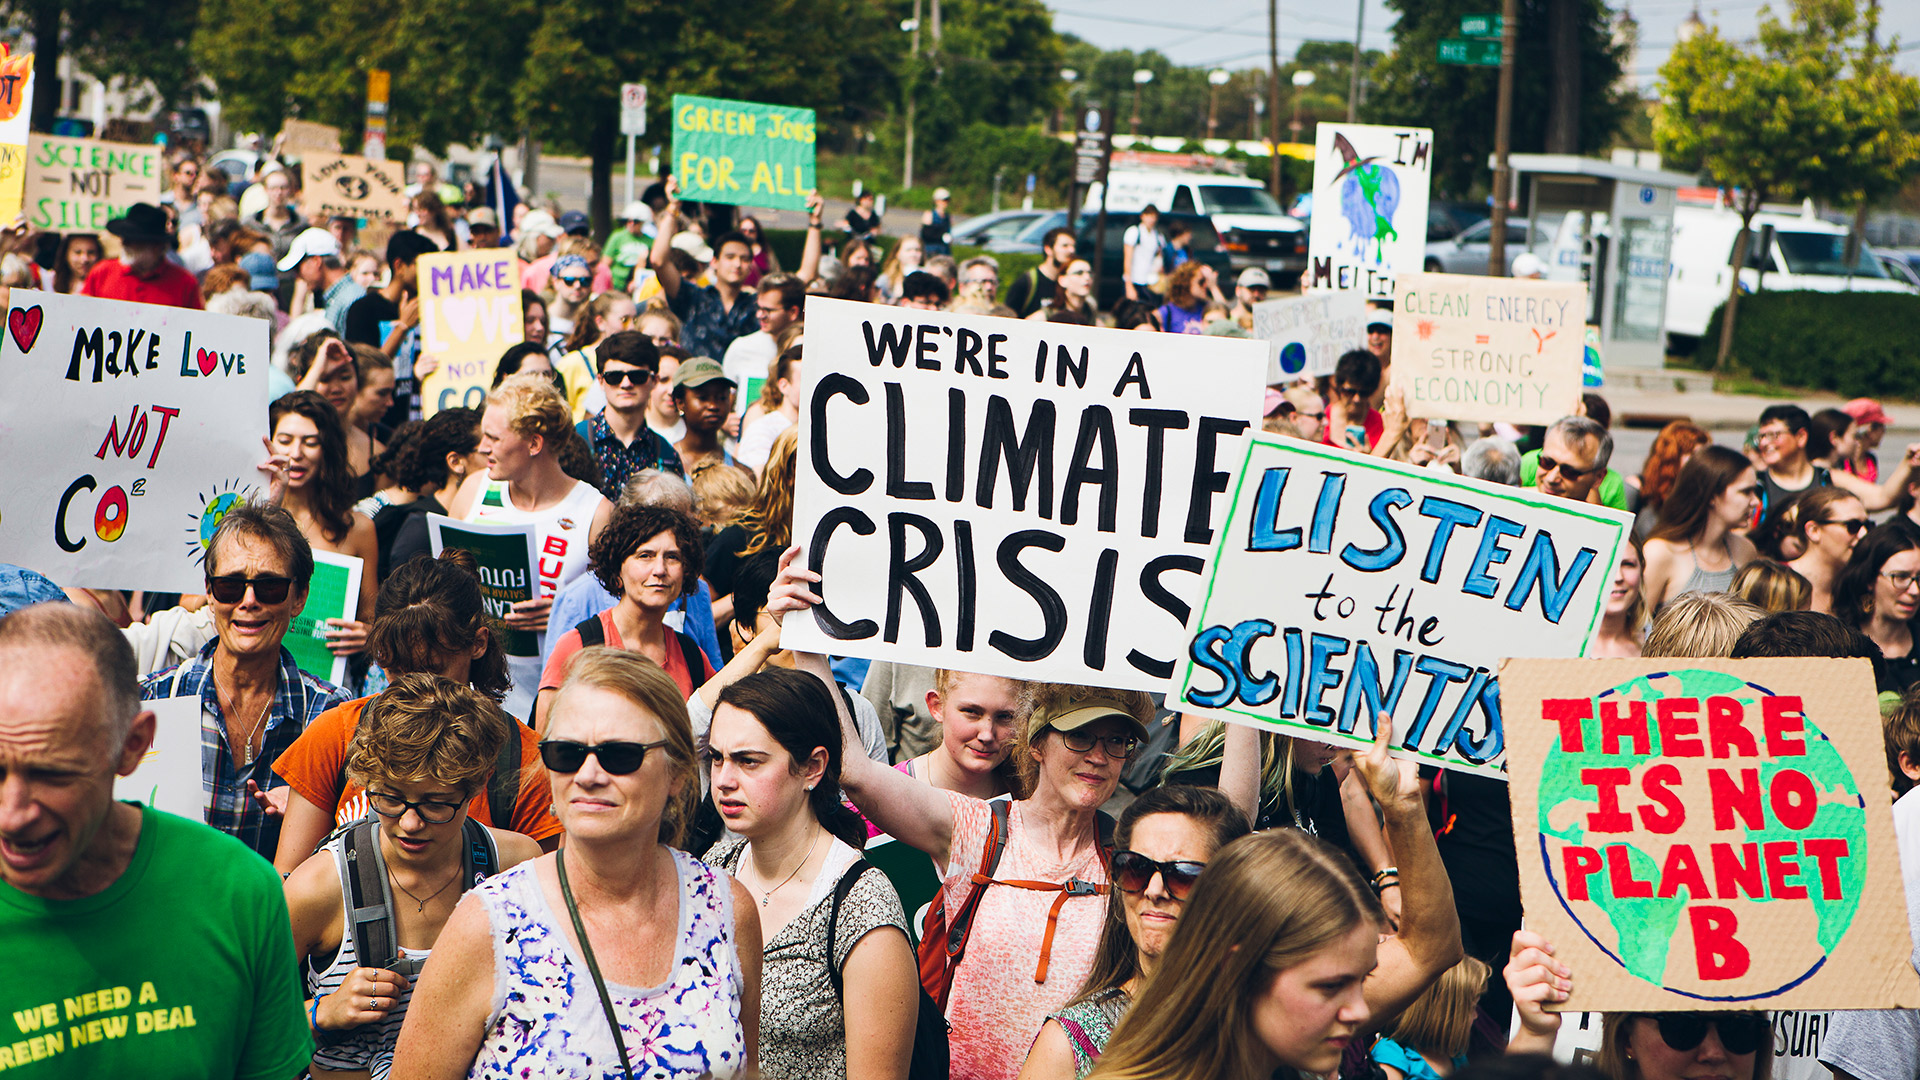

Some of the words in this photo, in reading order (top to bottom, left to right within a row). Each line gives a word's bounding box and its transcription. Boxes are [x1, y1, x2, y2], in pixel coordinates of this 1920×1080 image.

[677, 104, 756, 136] GREEN
[35, 142, 155, 178] SCIENCE
[680, 152, 740, 191] FOR
[752, 161, 813, 196] ALL
[70, 171, 112, 196] NOT
[31, 198, 133, 229] SILEN
[431, 262, 511, 296] MAKE
[1313, 256, 1396, 297] MELTI
[1253, 295, 1332, 339] RESPECT
[1404, 292, 1469, 317] CLEAN
[1486, 296, 1569, 327] ENERGY
[448, 360, 487, 380] NOT
[862, 320, 1009, 379] WE'RE
[1035, 340, 1089, 389] IN
[1113, 351, 1151, 399] A
[1431, 347, 1533, 378] STRONG
[1415, 377, 1549, 409] ECONOMY
[94, 404, 180, 469] NOT
[811, 373, 1250, 544] CLIMATE
[1244, 467, 1598, 624] LISTEN
[808, 506, 1205, 679] CRISIS
[1305, 573, 1355, 621] to
[1375, 583, 1444, 646] the
[1187, 618, 1506, 768] SCIENTIS
[1541, 695, 1807, 759] THERE
[1580, 763, 1686, 835] IS
[1707, 768, 1818, 831] NO
[1562, 838, 1849, 901] PLANET
[1688, 905, 1751, 981] B
[13, 1002, 59, 1034] WE
[63, 986, 132, 1021] NEED
[138, 981, 158, 1005] A
[69, 1015, 129, 1049] NEW
[135, 1005, 197, 1035] DEAL
